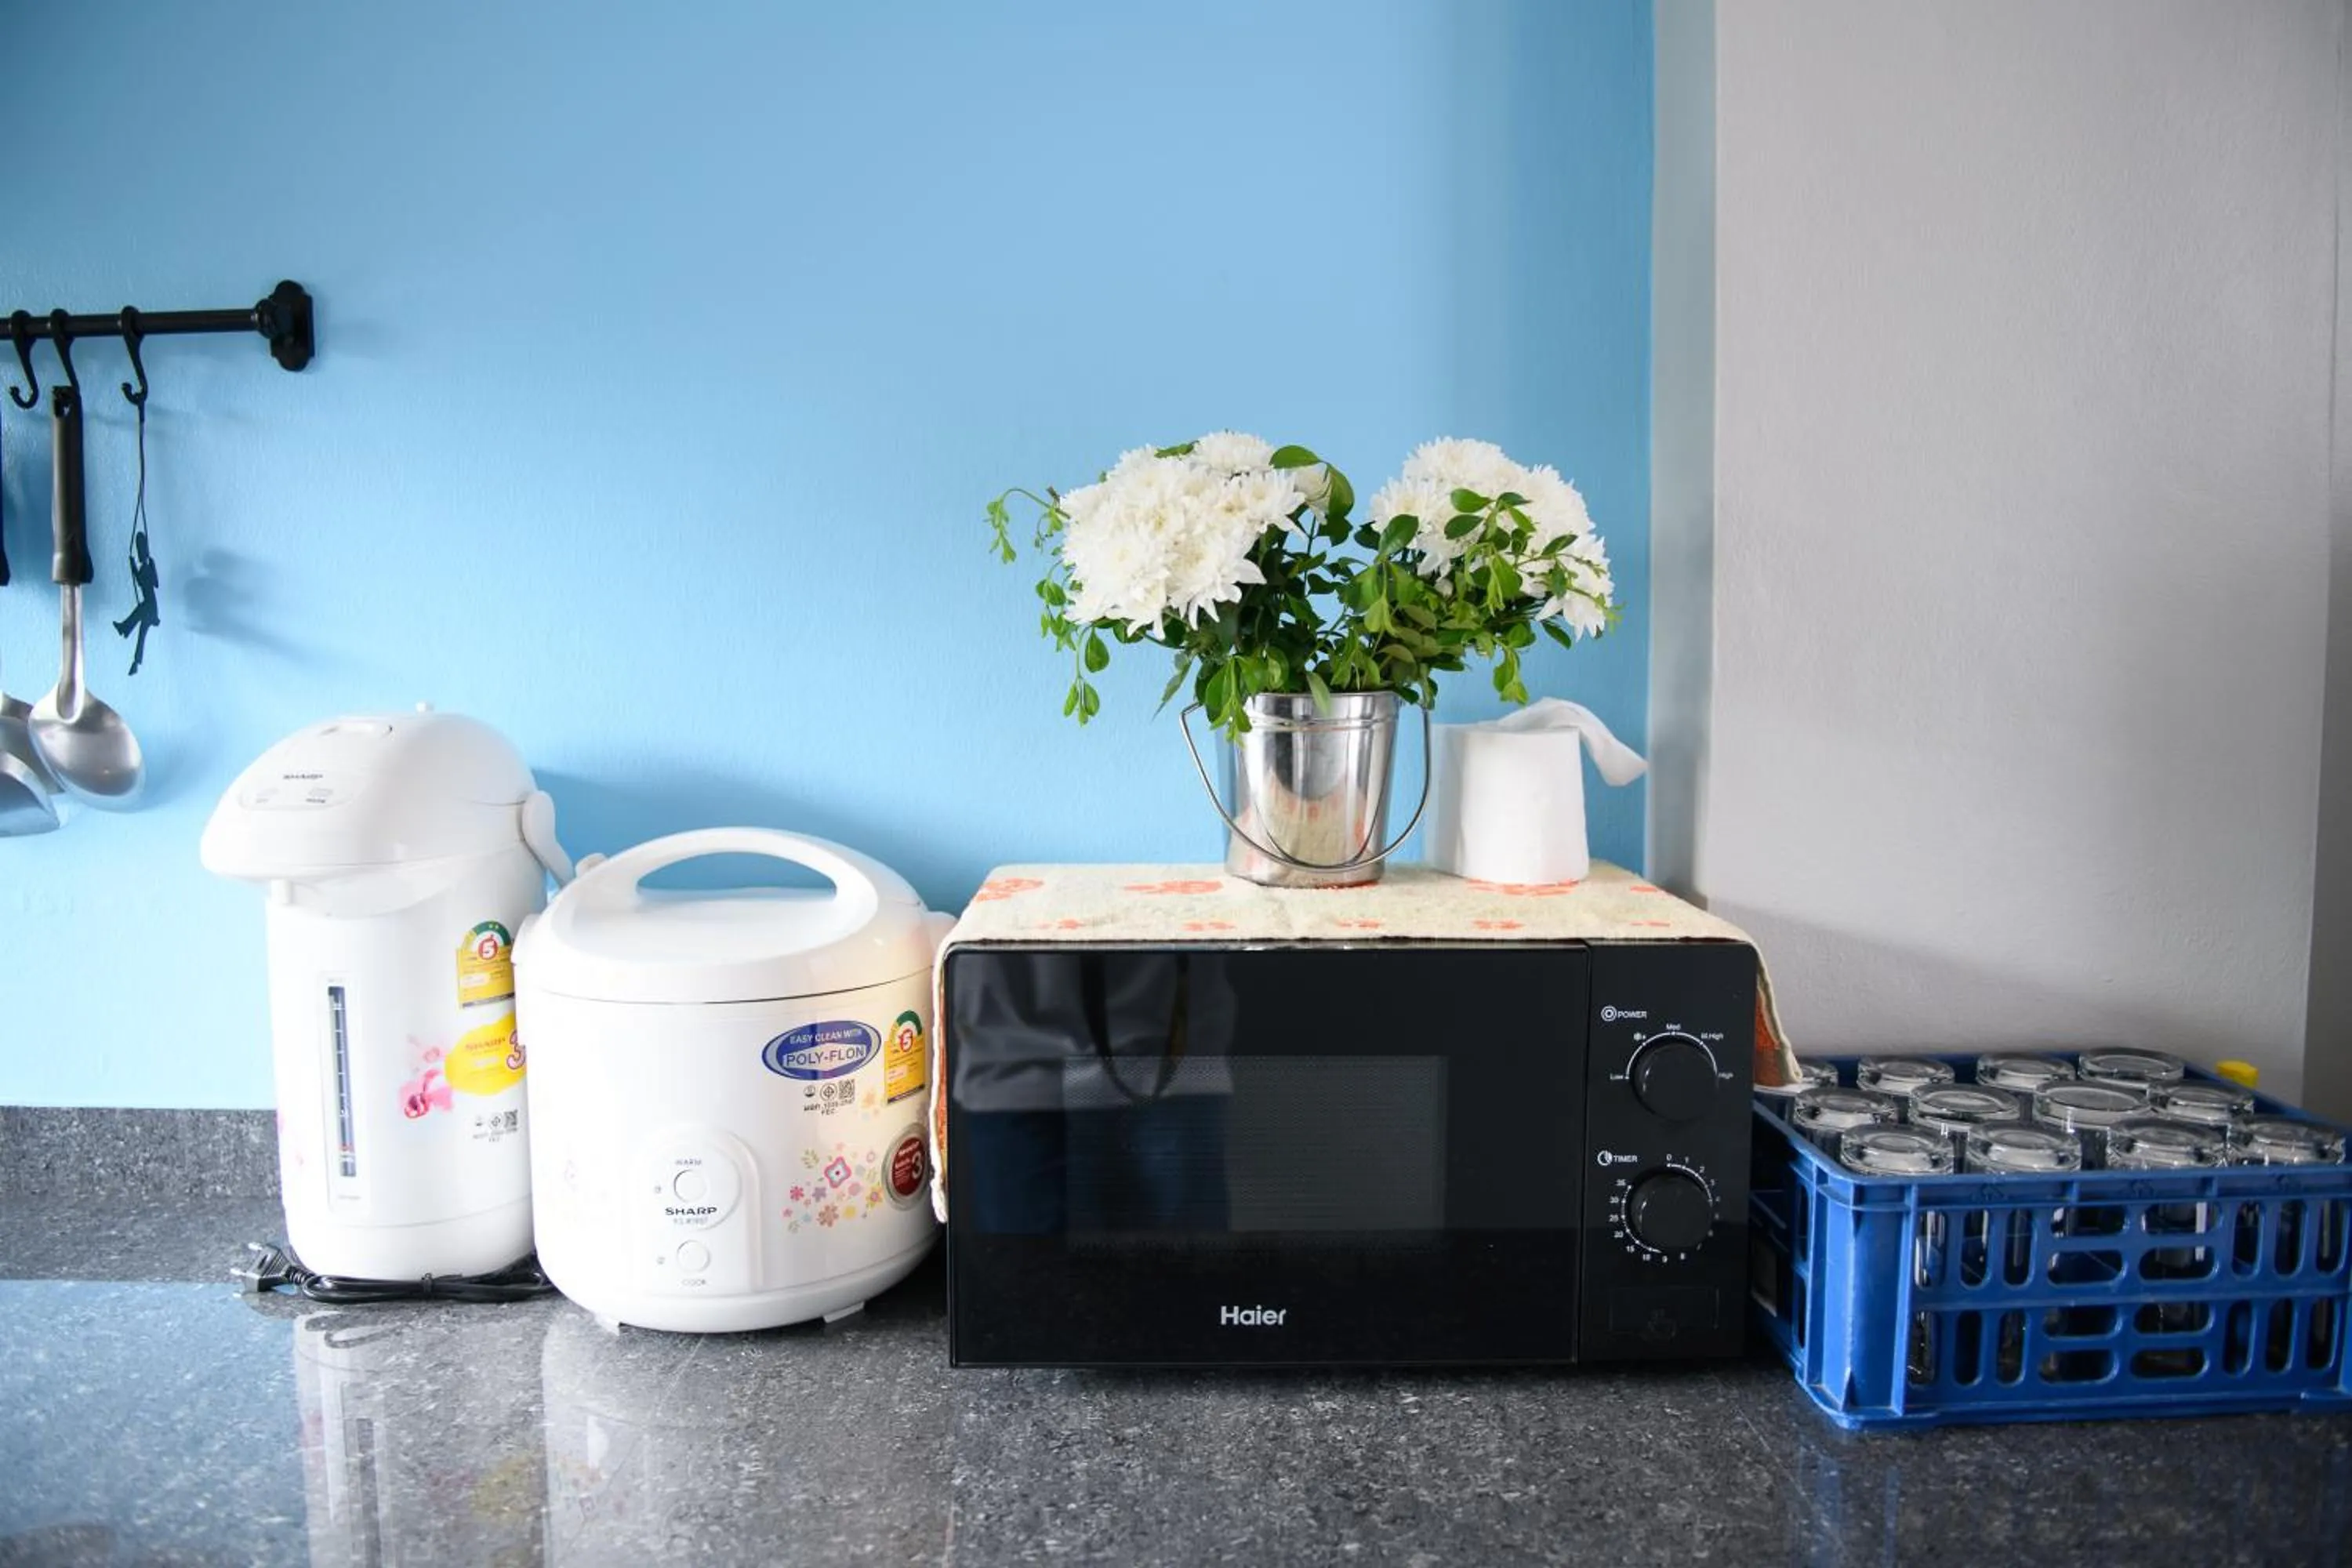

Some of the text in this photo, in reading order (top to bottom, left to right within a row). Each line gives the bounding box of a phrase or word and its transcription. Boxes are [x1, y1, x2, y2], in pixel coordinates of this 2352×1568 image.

[789, 1034, 813, 1045] EASY
[815, 1029, 843, 1042] CLEAN
[786, 1047, 866, 1066] POLY-FLON
[665, 1207, 717, 1216] SHARP
[1221, 1304, 1287, 1326] Haier
